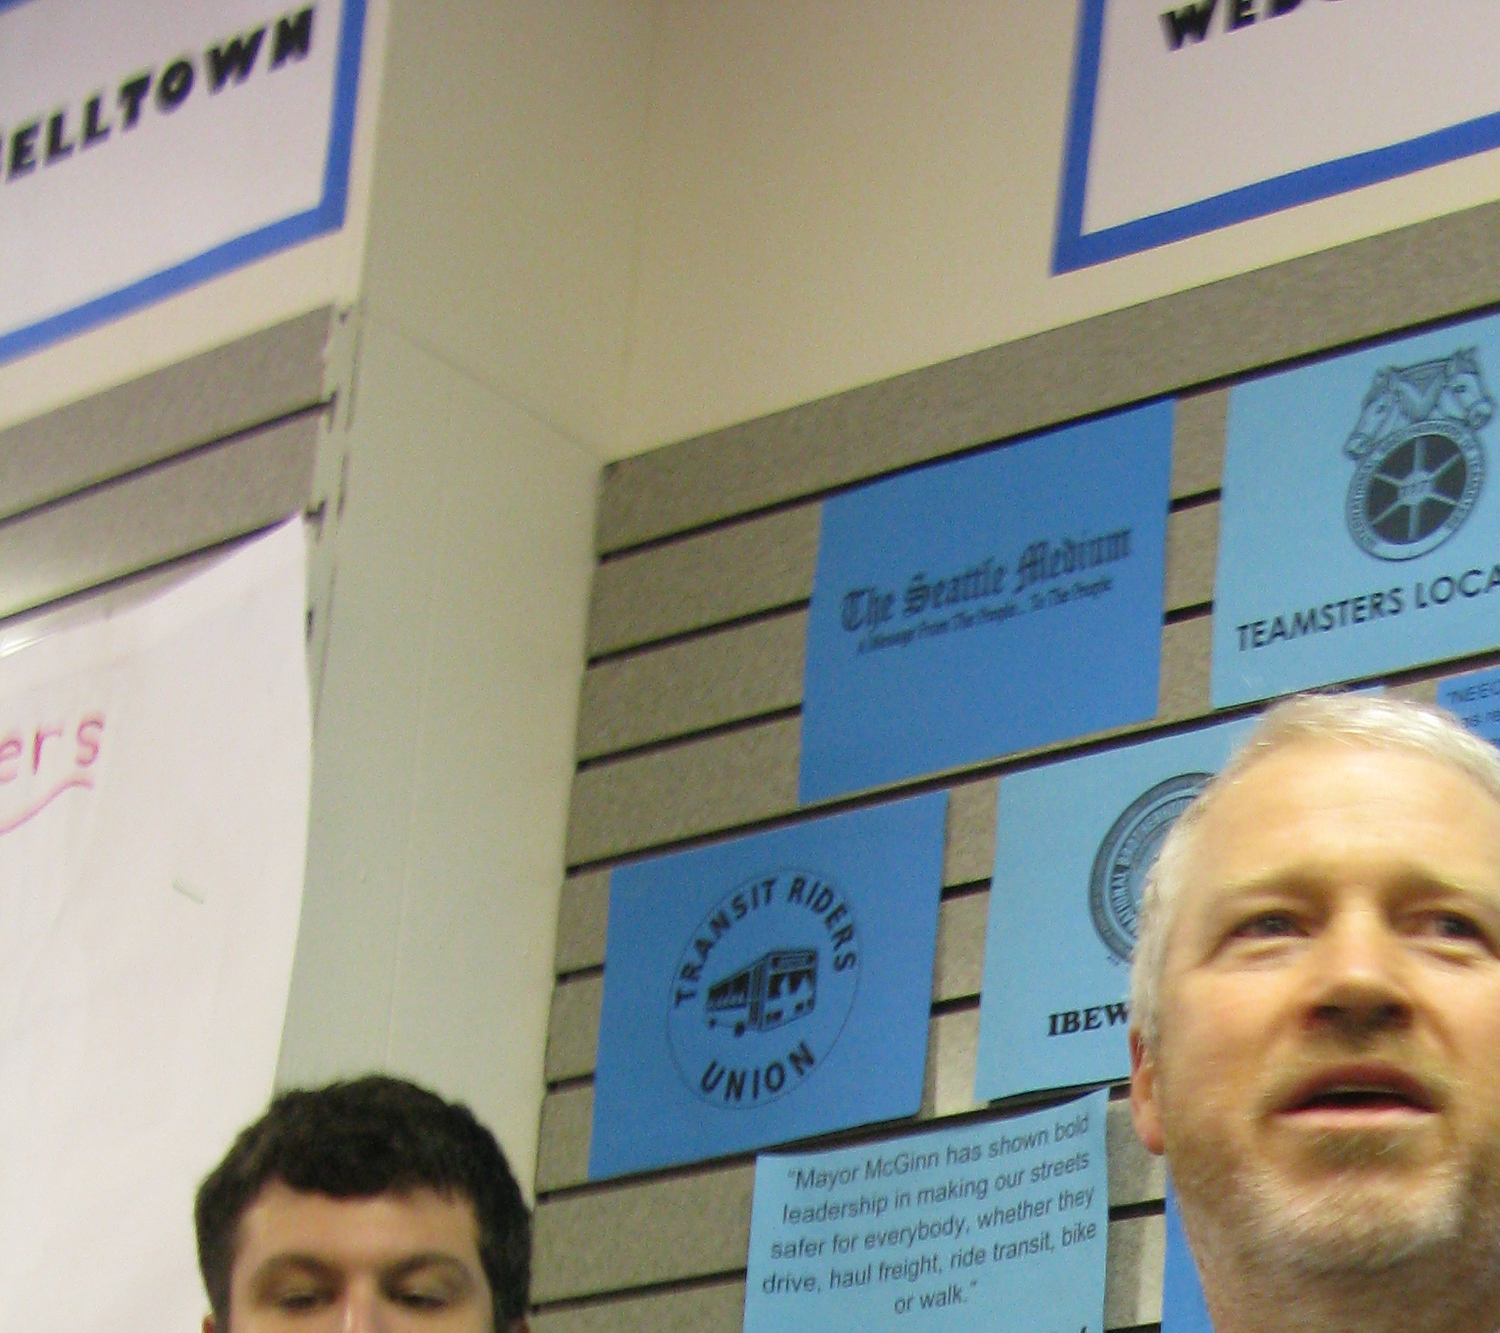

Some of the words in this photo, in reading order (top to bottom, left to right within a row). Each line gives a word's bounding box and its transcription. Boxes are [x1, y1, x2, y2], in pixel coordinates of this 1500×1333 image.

[0, 8, 314, 184] ELLTOWN
[841, 585, 895, 633] The
[903, 554, 1007, 617] Seattle
[1236, 587, 1405, 652] TEAMSTERS
[674, 877, 778, 1010] TRANSIT
[787, 874, 858, 974] RIDERS
[700, 1040, 815, 1102] UNION
[864, 1152, 939, 1182] McGinn
[945, 1142, 982, 1165] has
[988, 1130, 1050, 1159] shown
[1054, 1112, 1090, 1144] bold
[770, 1235, 825, 1261] safer
[831, 1232, 857, 1256] for
[864, 1214, 970, 1249] everybody,
[977, 1197, 1052, 1229] whether
[1058, 1184, 1095, 1212] they
[782, 1189, 888, 1225] leadership
[894, 1187, 911, 1209] in
[917, 1175, 988, 1205] making
[994, 1170, 1023, 1191] our
[1029, 1150, 1091, 1183] streets
[761, 1271, 821, 1295] drive,
[829, 1262, 872, 1290] haul
[878, 1252, 943, 1284] freight,
[949, 1243, 986, 1269] ride
[993, 1232, 1055, 1262] transit,
[1061, 1219, 1097, 1248] bike
[894, 1296, 913, 1316] or
